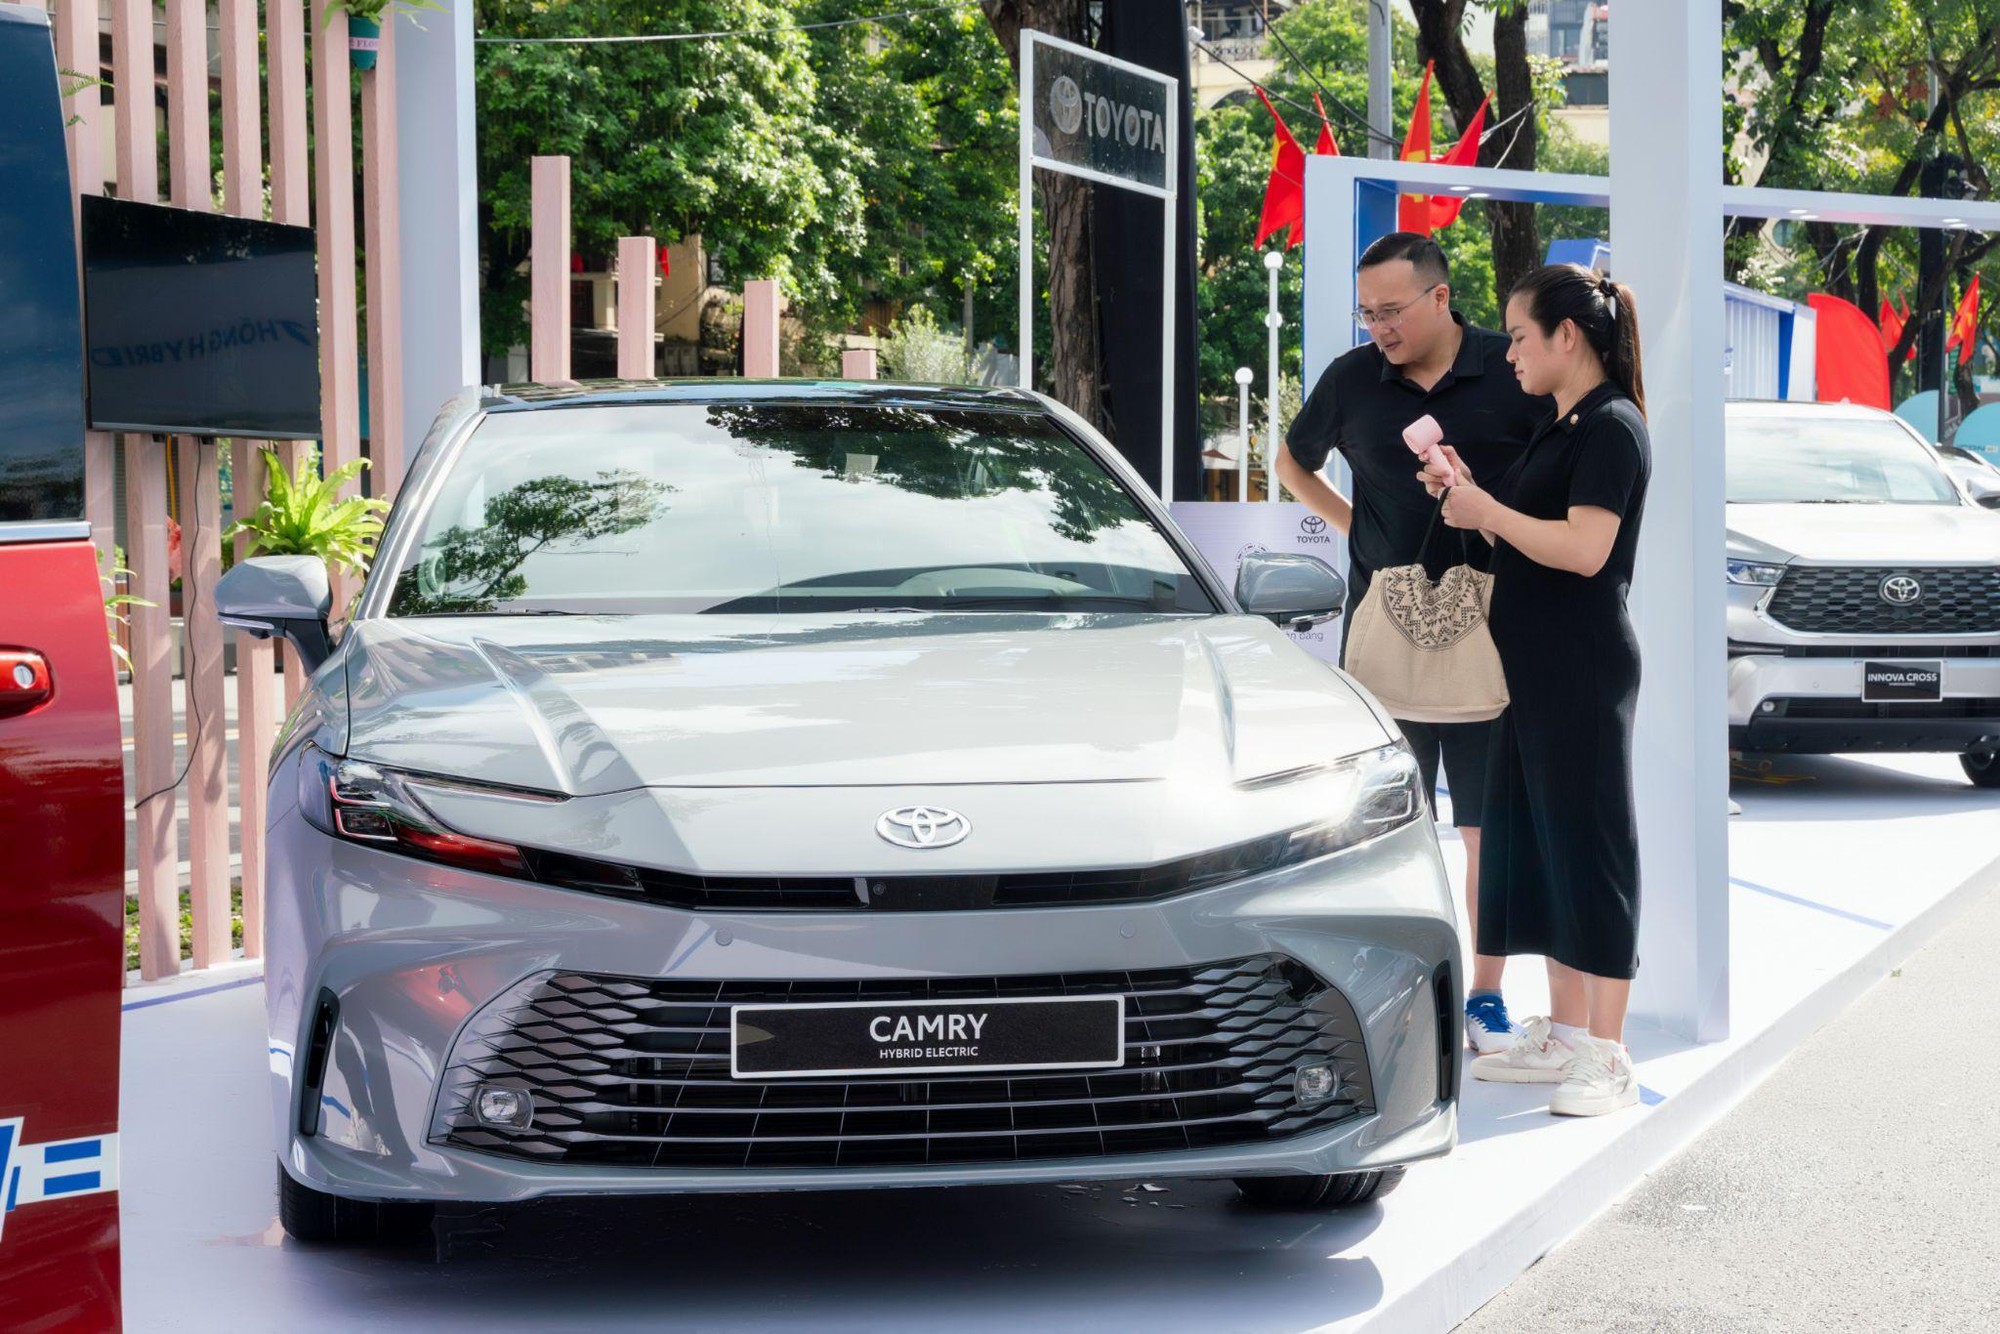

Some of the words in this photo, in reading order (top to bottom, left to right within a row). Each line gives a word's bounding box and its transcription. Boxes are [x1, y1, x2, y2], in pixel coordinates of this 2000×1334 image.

[1084, 91, 1164, 154] TOYOTA
[1297, 535, 1331, 544] TOYOTA
[1867, 672, 1905, 682] INNOVA
[1906, 672, 1938, 682] CROSS
[869, 1013, 989, 1043] CAMRY
[880, 1047, 923, 1059] HYBRID
[925, 1046, 979, 1058] ELECTRIC
